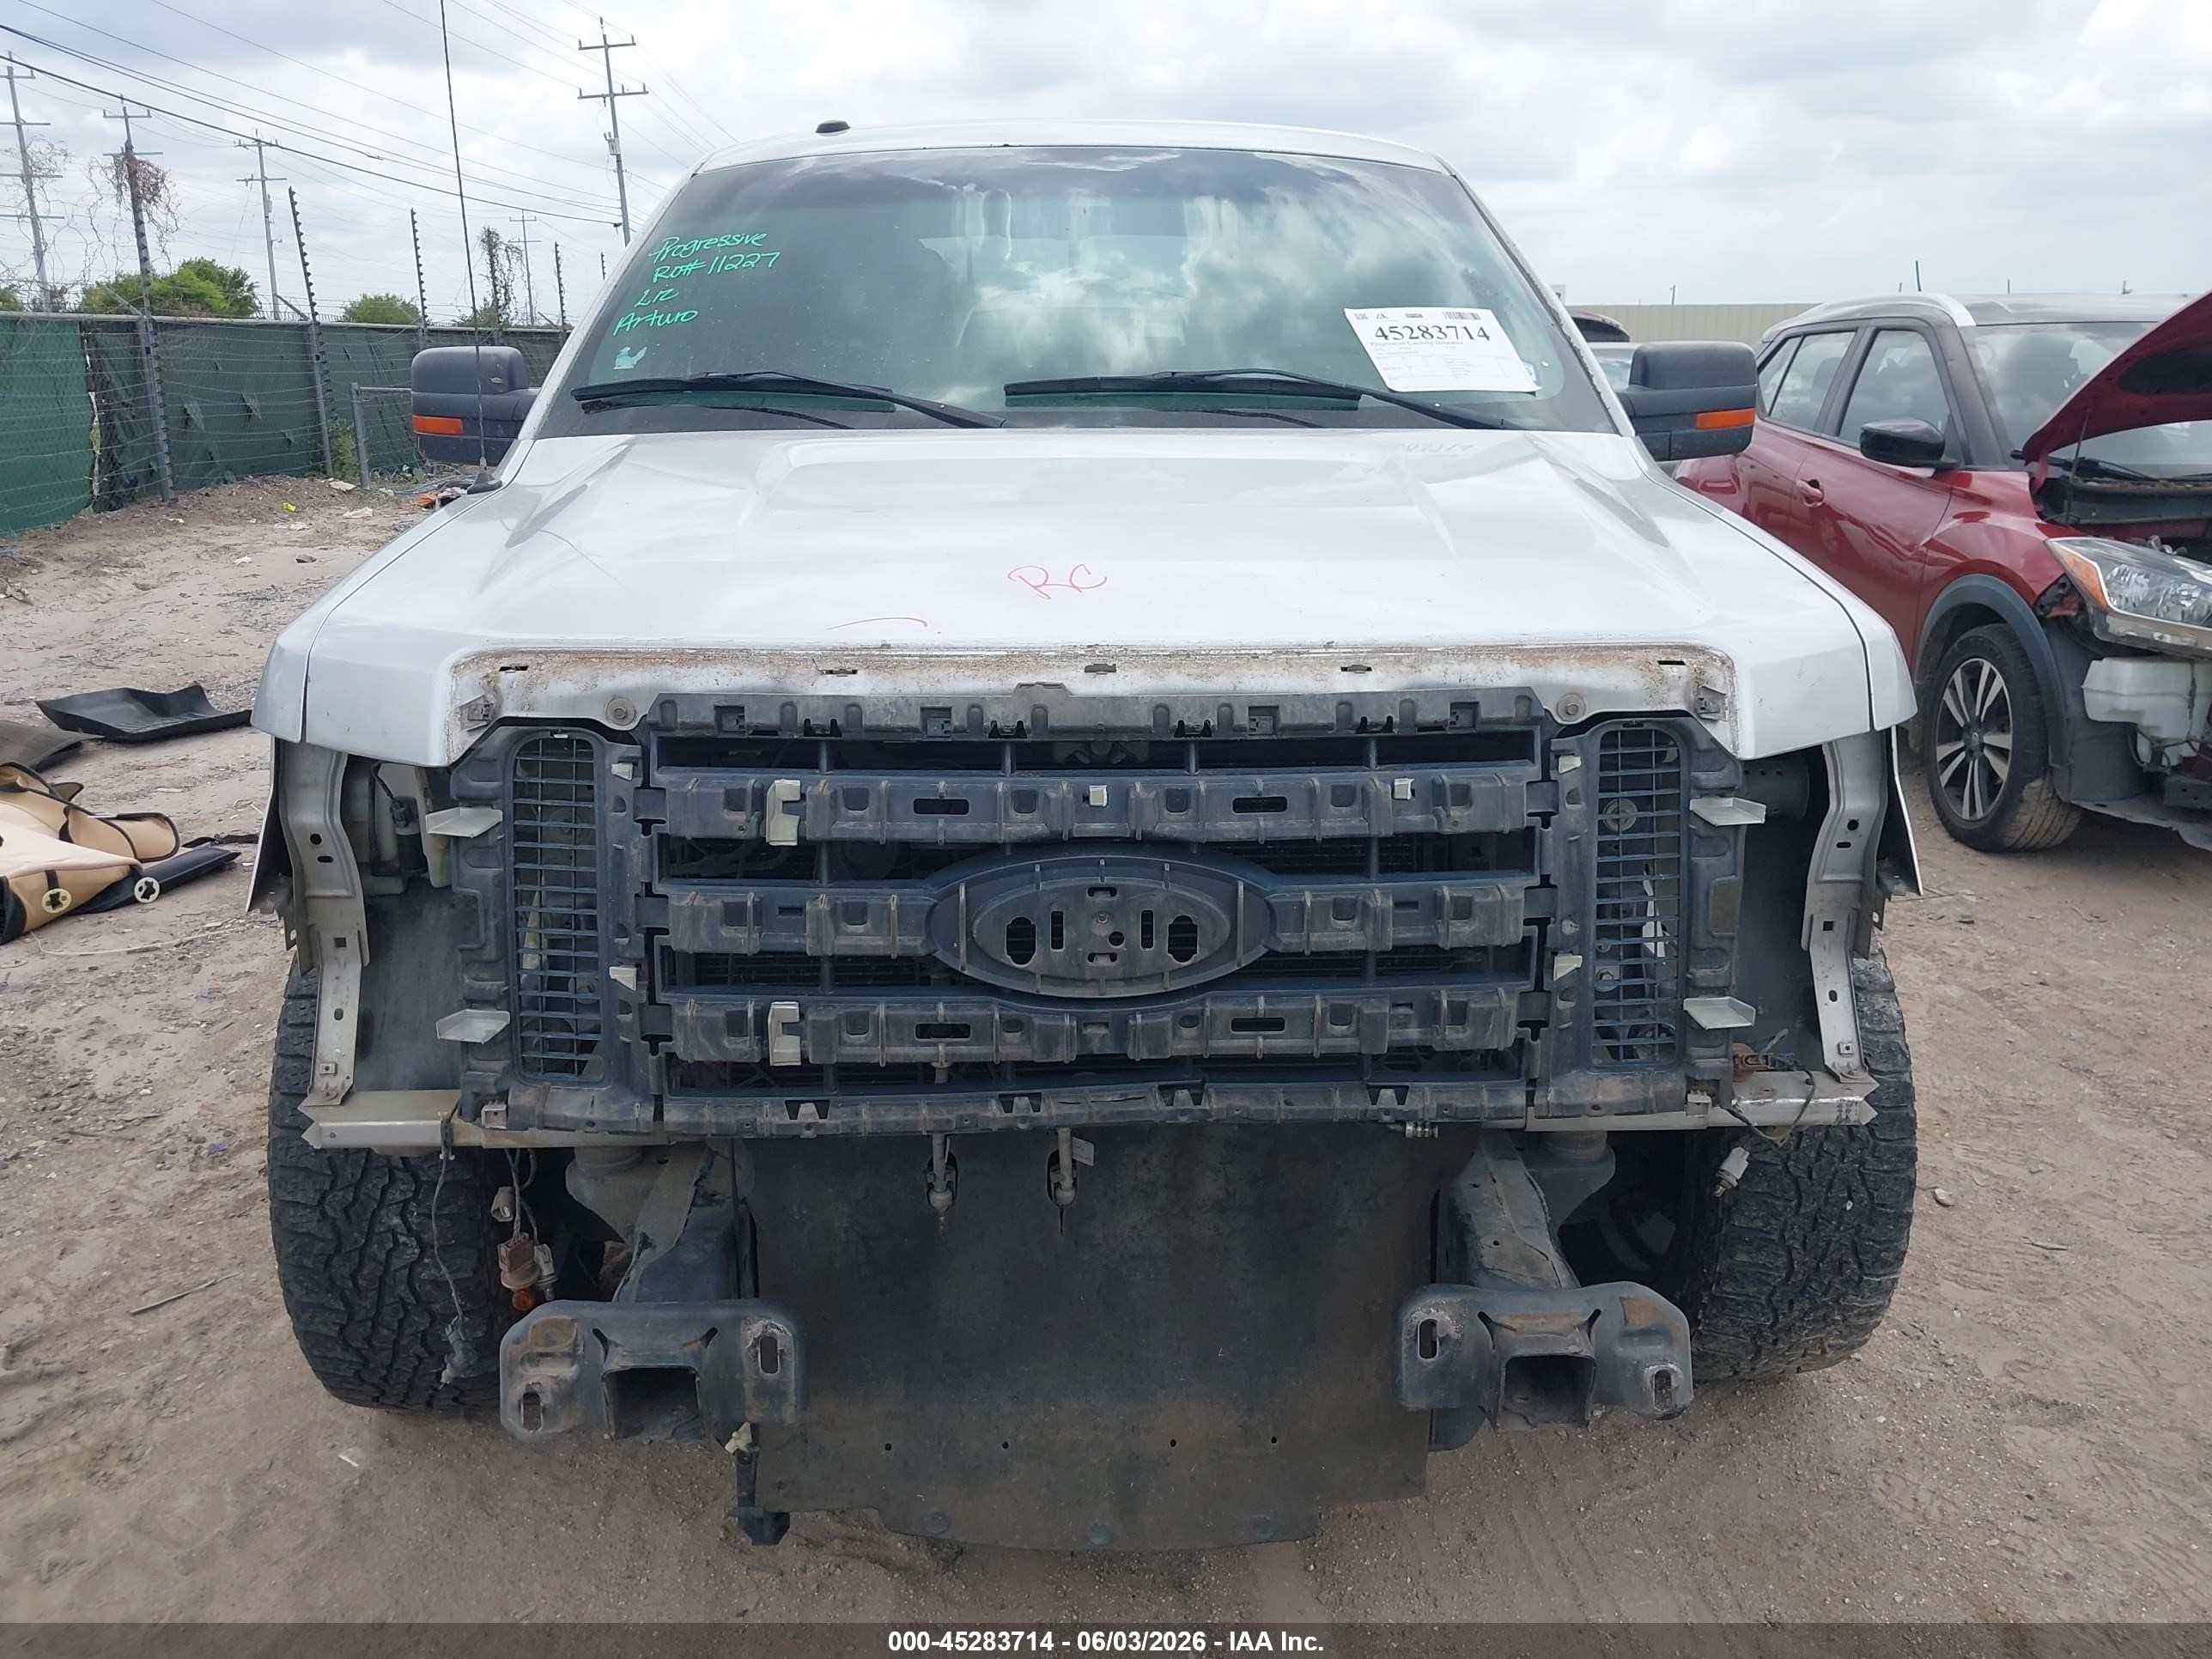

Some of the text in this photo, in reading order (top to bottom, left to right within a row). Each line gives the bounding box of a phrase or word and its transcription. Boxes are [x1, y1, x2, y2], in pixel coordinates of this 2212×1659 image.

[649, 231, 769, 264] Progressive
[612, 309, 698, 336] Arturo
[1375, 325, 1491, 341] 45283714
